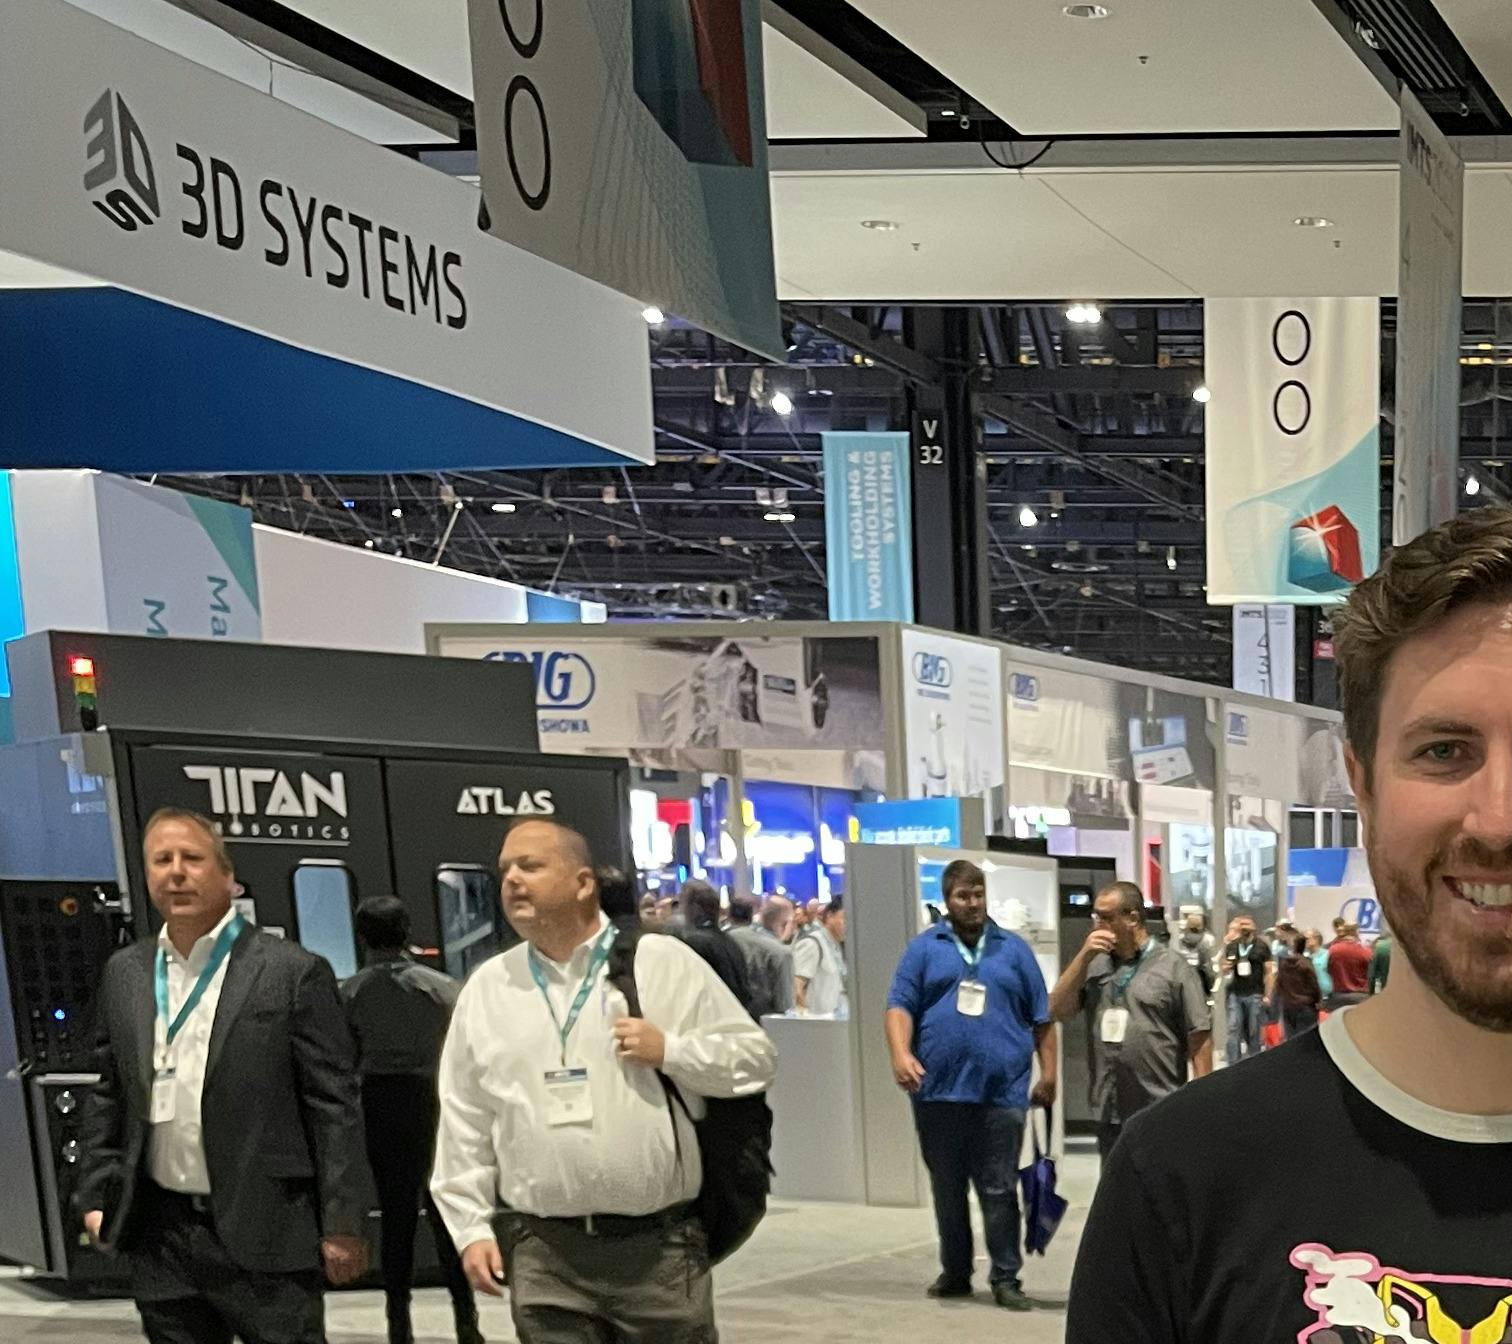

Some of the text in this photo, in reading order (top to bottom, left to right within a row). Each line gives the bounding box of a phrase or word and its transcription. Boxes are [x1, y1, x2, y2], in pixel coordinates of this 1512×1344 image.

[174, 142, 468, 330] 3D SYSTEMS
[919, 446, 944, 464] 32
[922, 420, 938, 438] V
[847, 470, 864, 560] TOOLING
[863, 451, 882, 609] WORKHOLDING
[880, 451, 896, 544] SYSTEMS
[183, 765, 348, 818] TITAN
[456, 786, 554, 815] ATLAS
